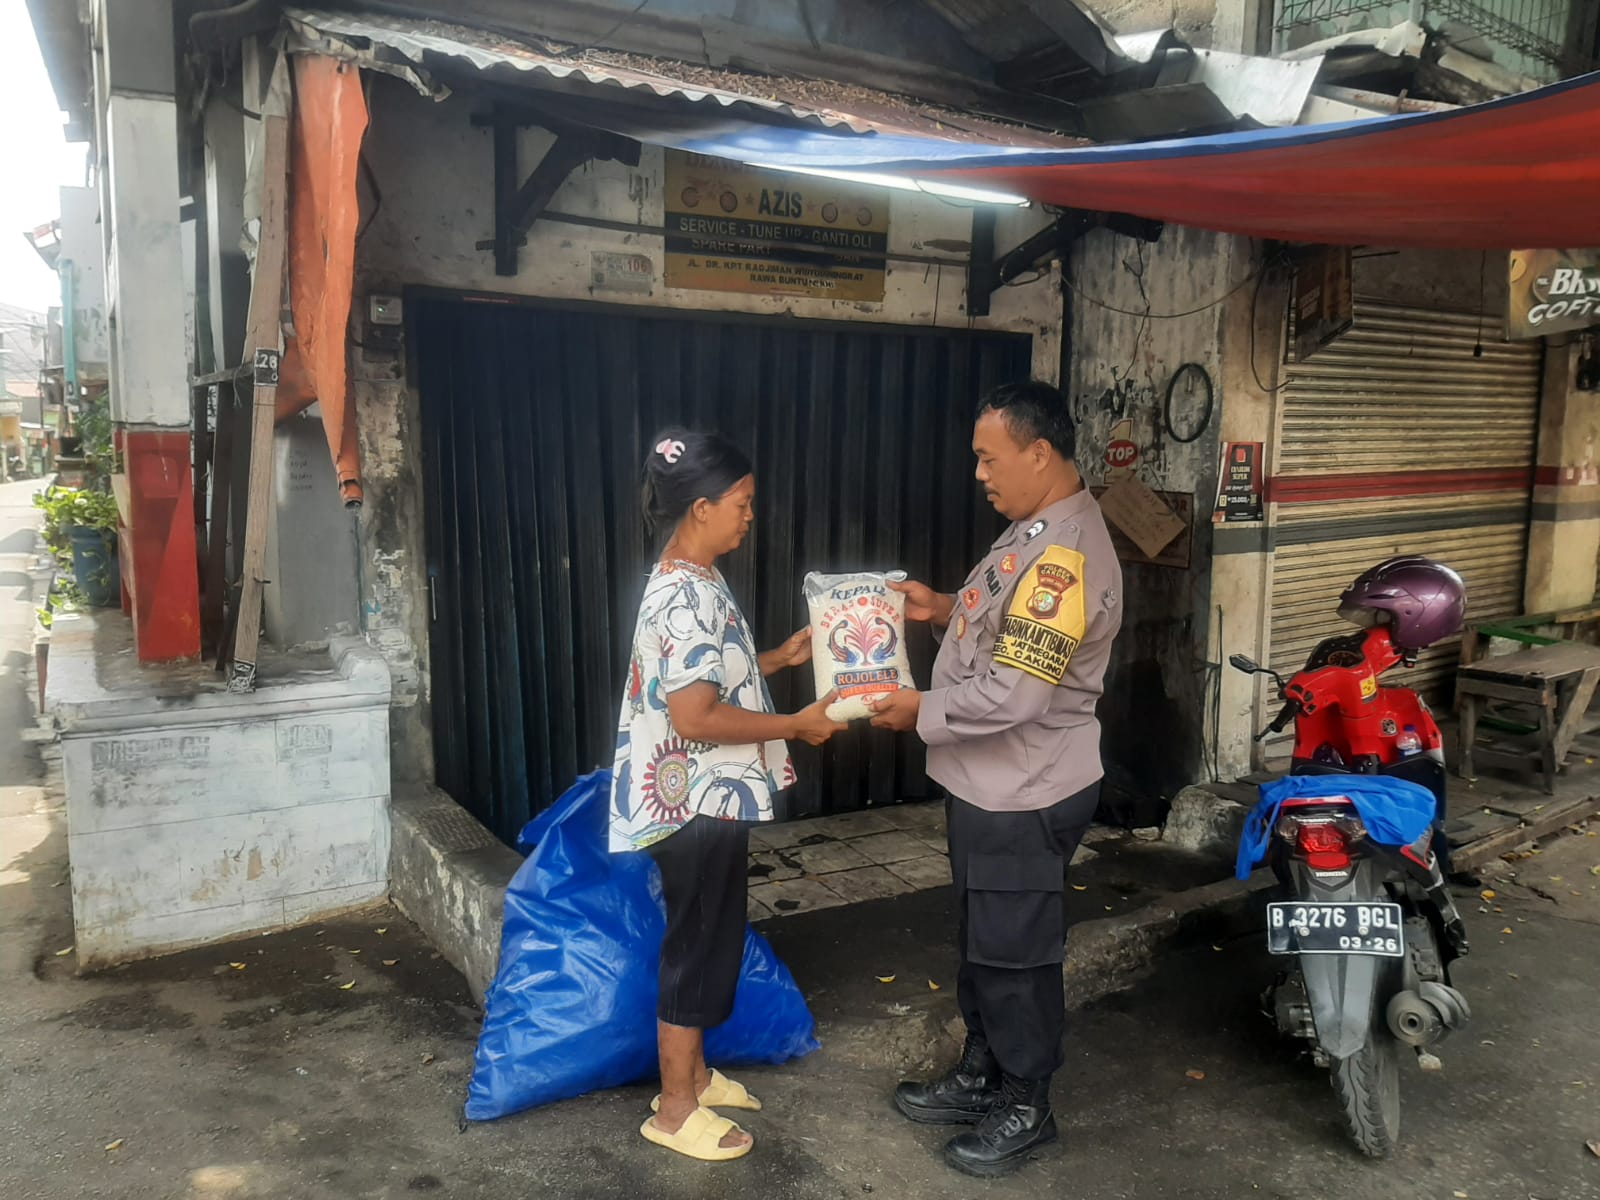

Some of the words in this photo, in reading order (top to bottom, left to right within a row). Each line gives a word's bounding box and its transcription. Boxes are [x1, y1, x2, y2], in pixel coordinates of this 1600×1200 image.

[758, 188, 803, 218] AZIS
[680, 217, 737, 236] SERVICE
[748, 223, 781, 240] TUNE
[812, 230, 849, 246] GANTI
[852, 233, 872, 249] OLI
[691, 239, 736, 253] SPARE
[627, 257, 648, 273] 106
[1107, 446, 1134, 462] TOP
[870, 595, 900, 623] SUPER
[1010, 638, 1066, 668] JATINEGARA
[1014, 650, 1062, 676] CAKUNG
[837, 669, 898, 685] ROJOLELE
[1272, 908, 1284, 928] B
[1295, 907, 1347, 929] 3276
[1357, 906, 1398, 929] BGL
